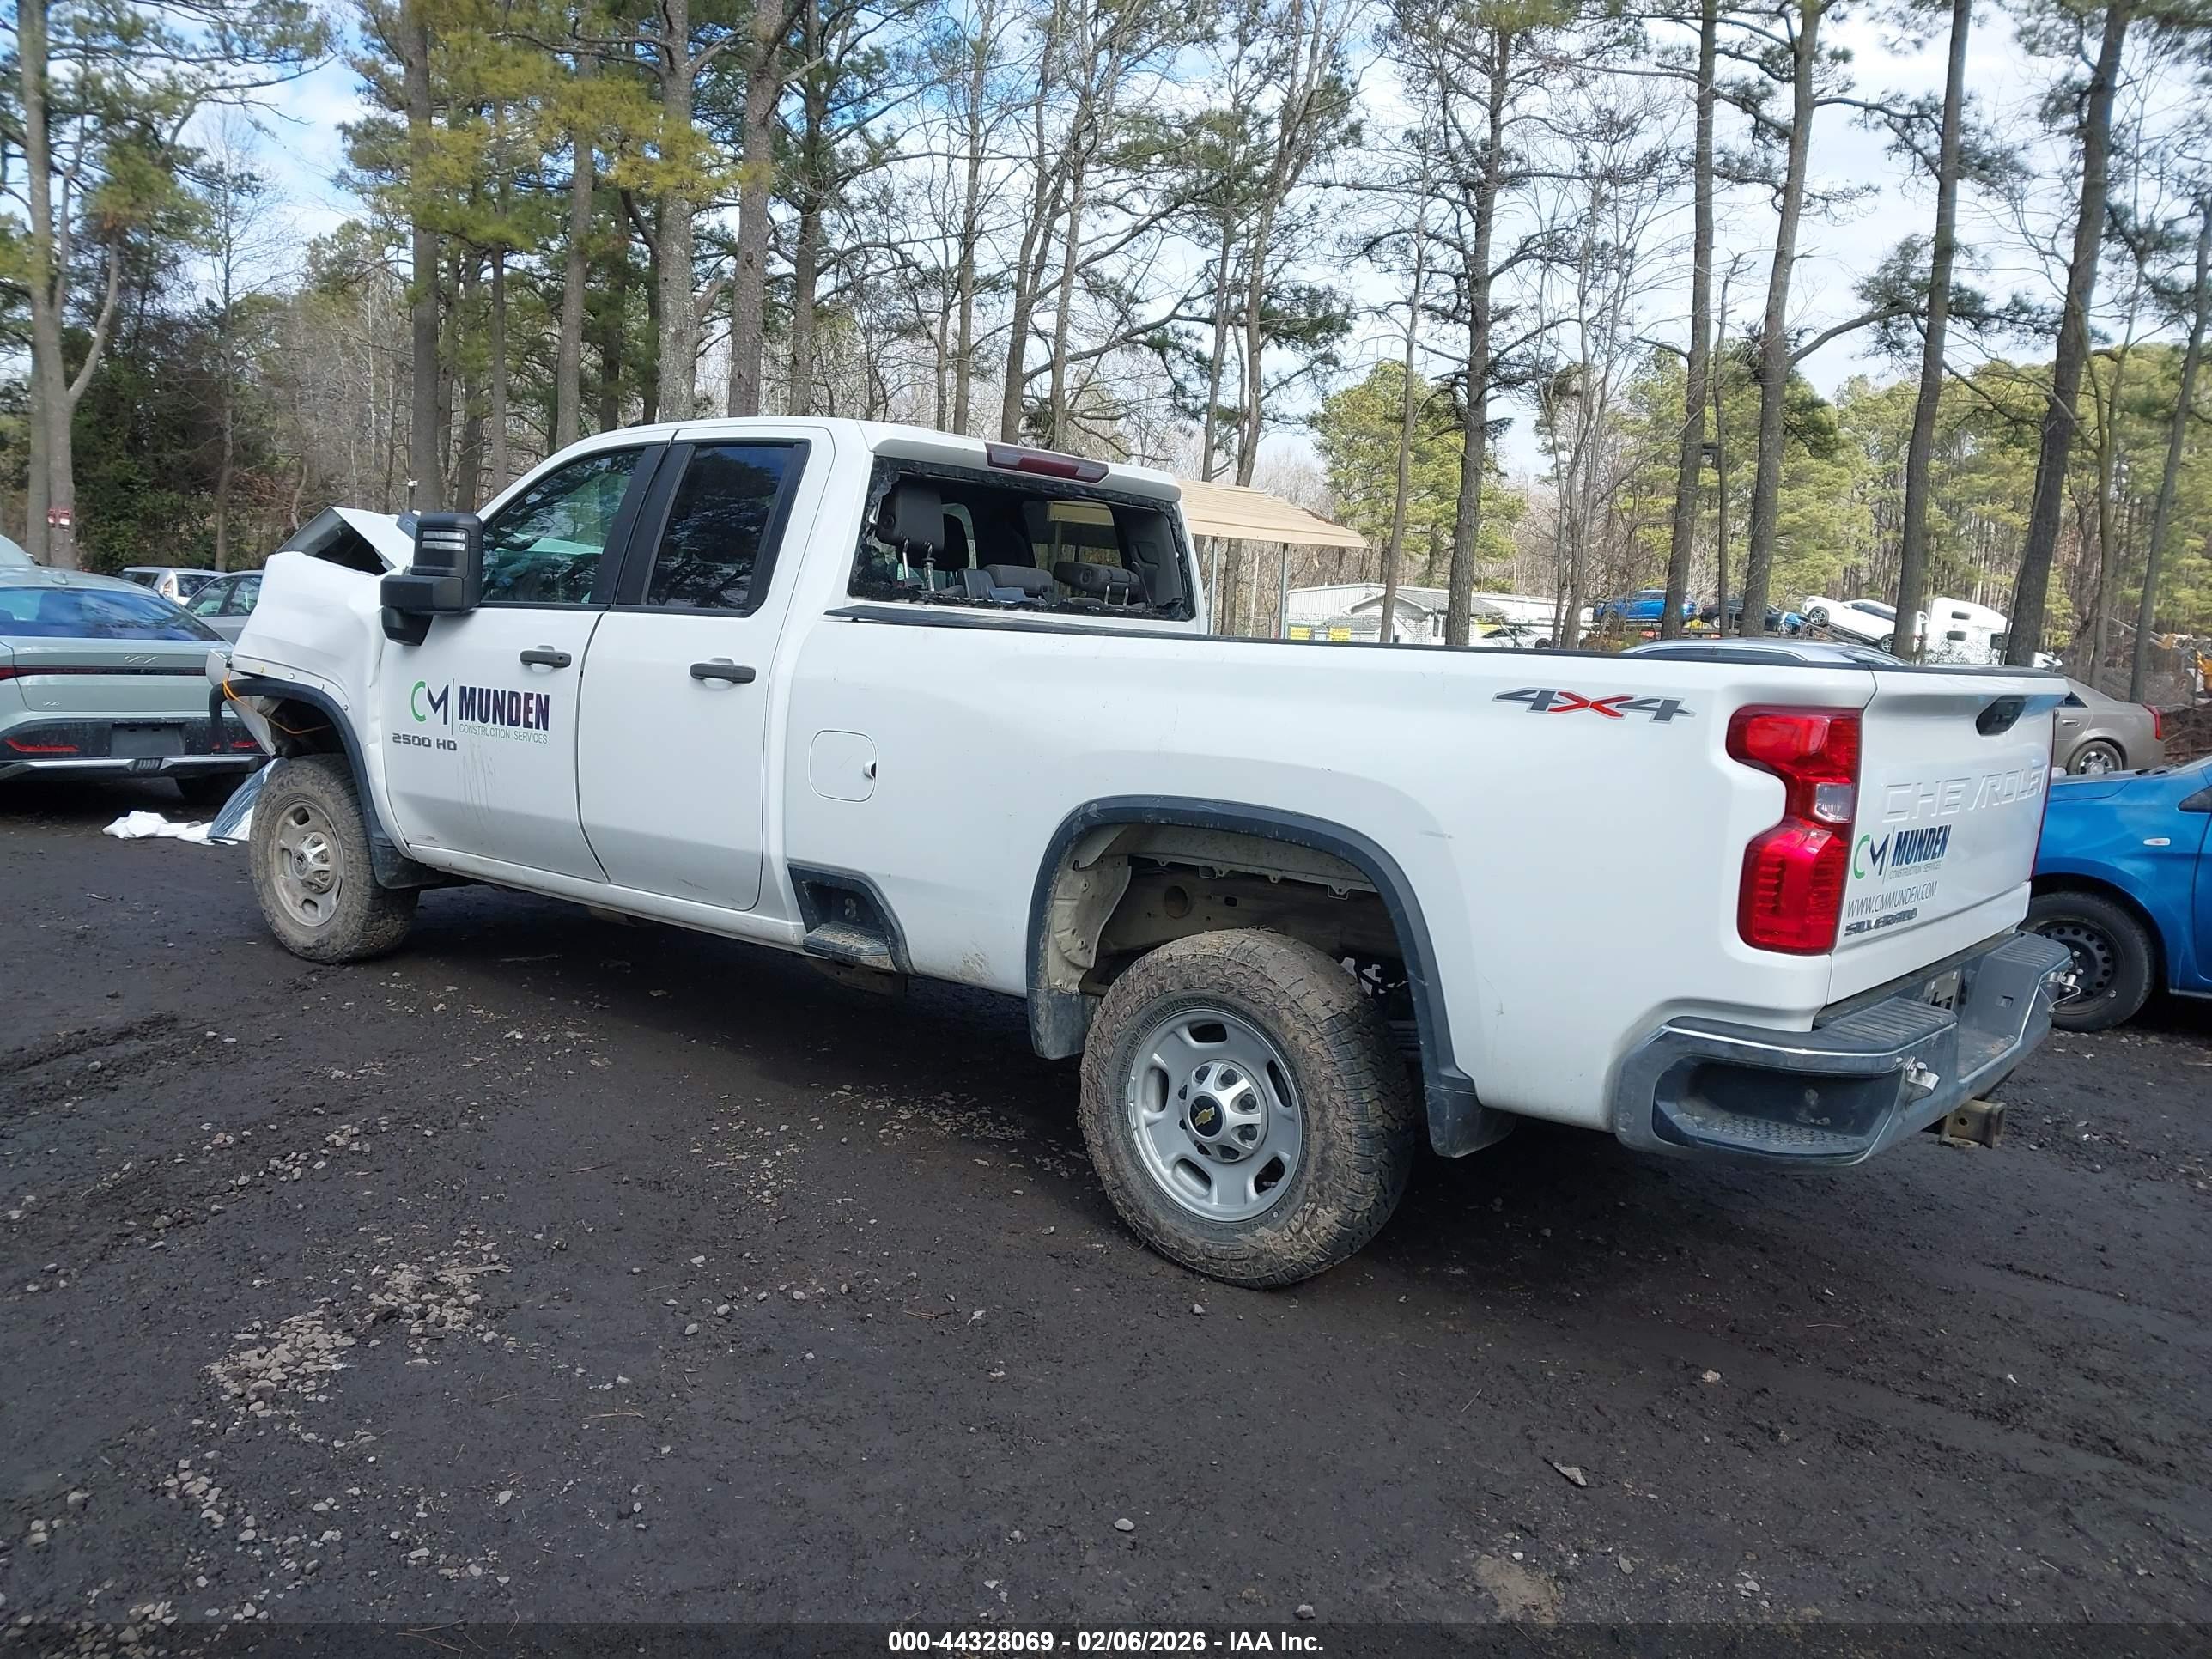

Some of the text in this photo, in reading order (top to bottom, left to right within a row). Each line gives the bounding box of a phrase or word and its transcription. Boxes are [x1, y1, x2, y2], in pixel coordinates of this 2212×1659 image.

[458, 685, 550, 731] MUNDEN
[392, 732, 458, 751] 2500 HD
[459, 723, 548, 744] CONSTRUCTION SERVICES
[1881, 764, 2048, 823] CHEVROLET
[1891, 824, 1952, 866] MUNDEN
[1847, 880, 1938, 918] WWW.CMMUNDEN.COM
